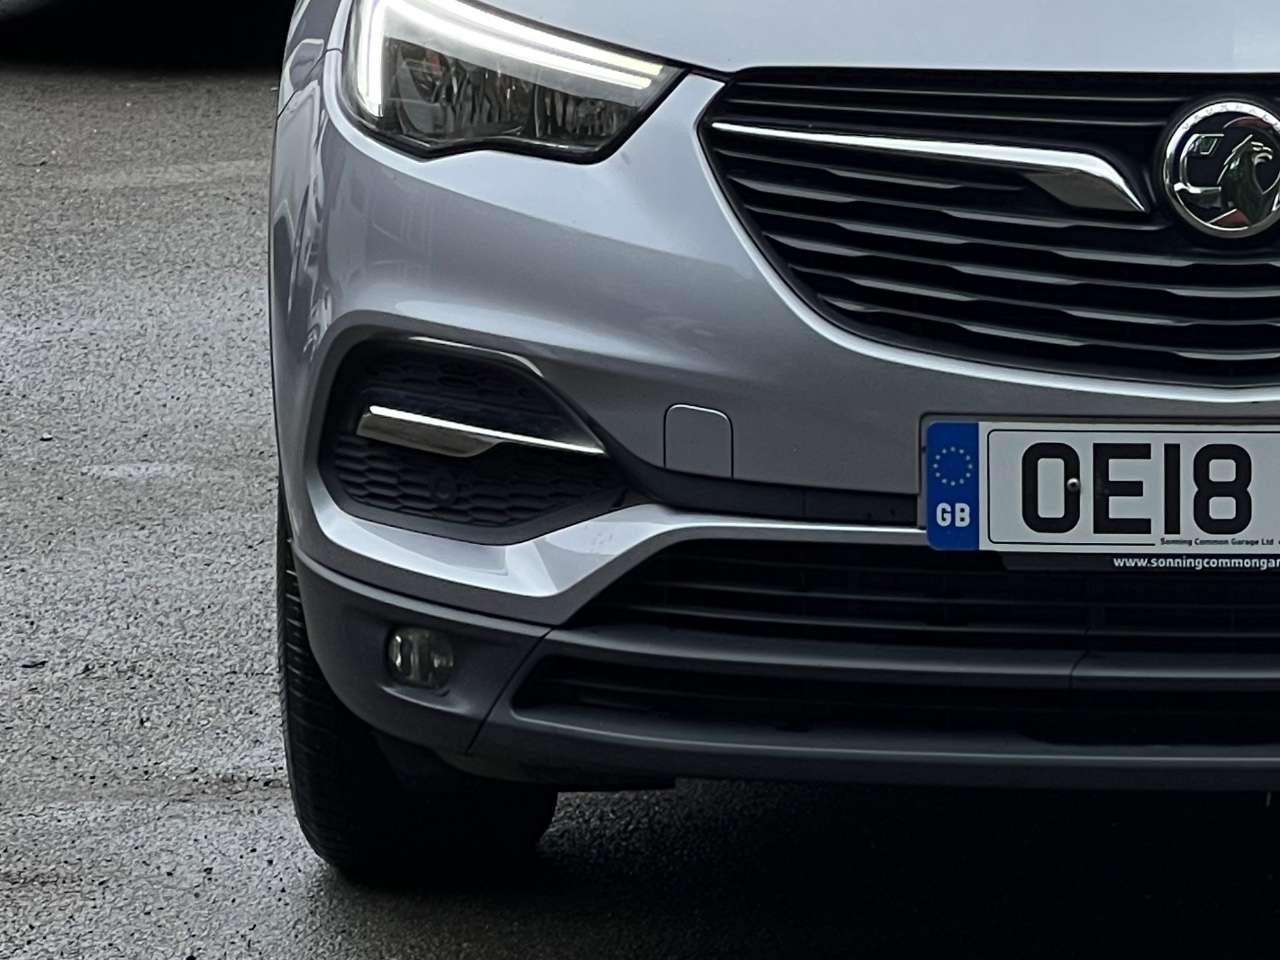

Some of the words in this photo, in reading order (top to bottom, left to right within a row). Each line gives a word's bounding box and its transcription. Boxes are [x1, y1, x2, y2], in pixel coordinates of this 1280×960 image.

[1021, 442, 1252, 535] OE18
[936, 502, 971, 528] GB
[1160, 538, 1193, 546] Sonning
[1231, 538, 1259, 546] Garage
